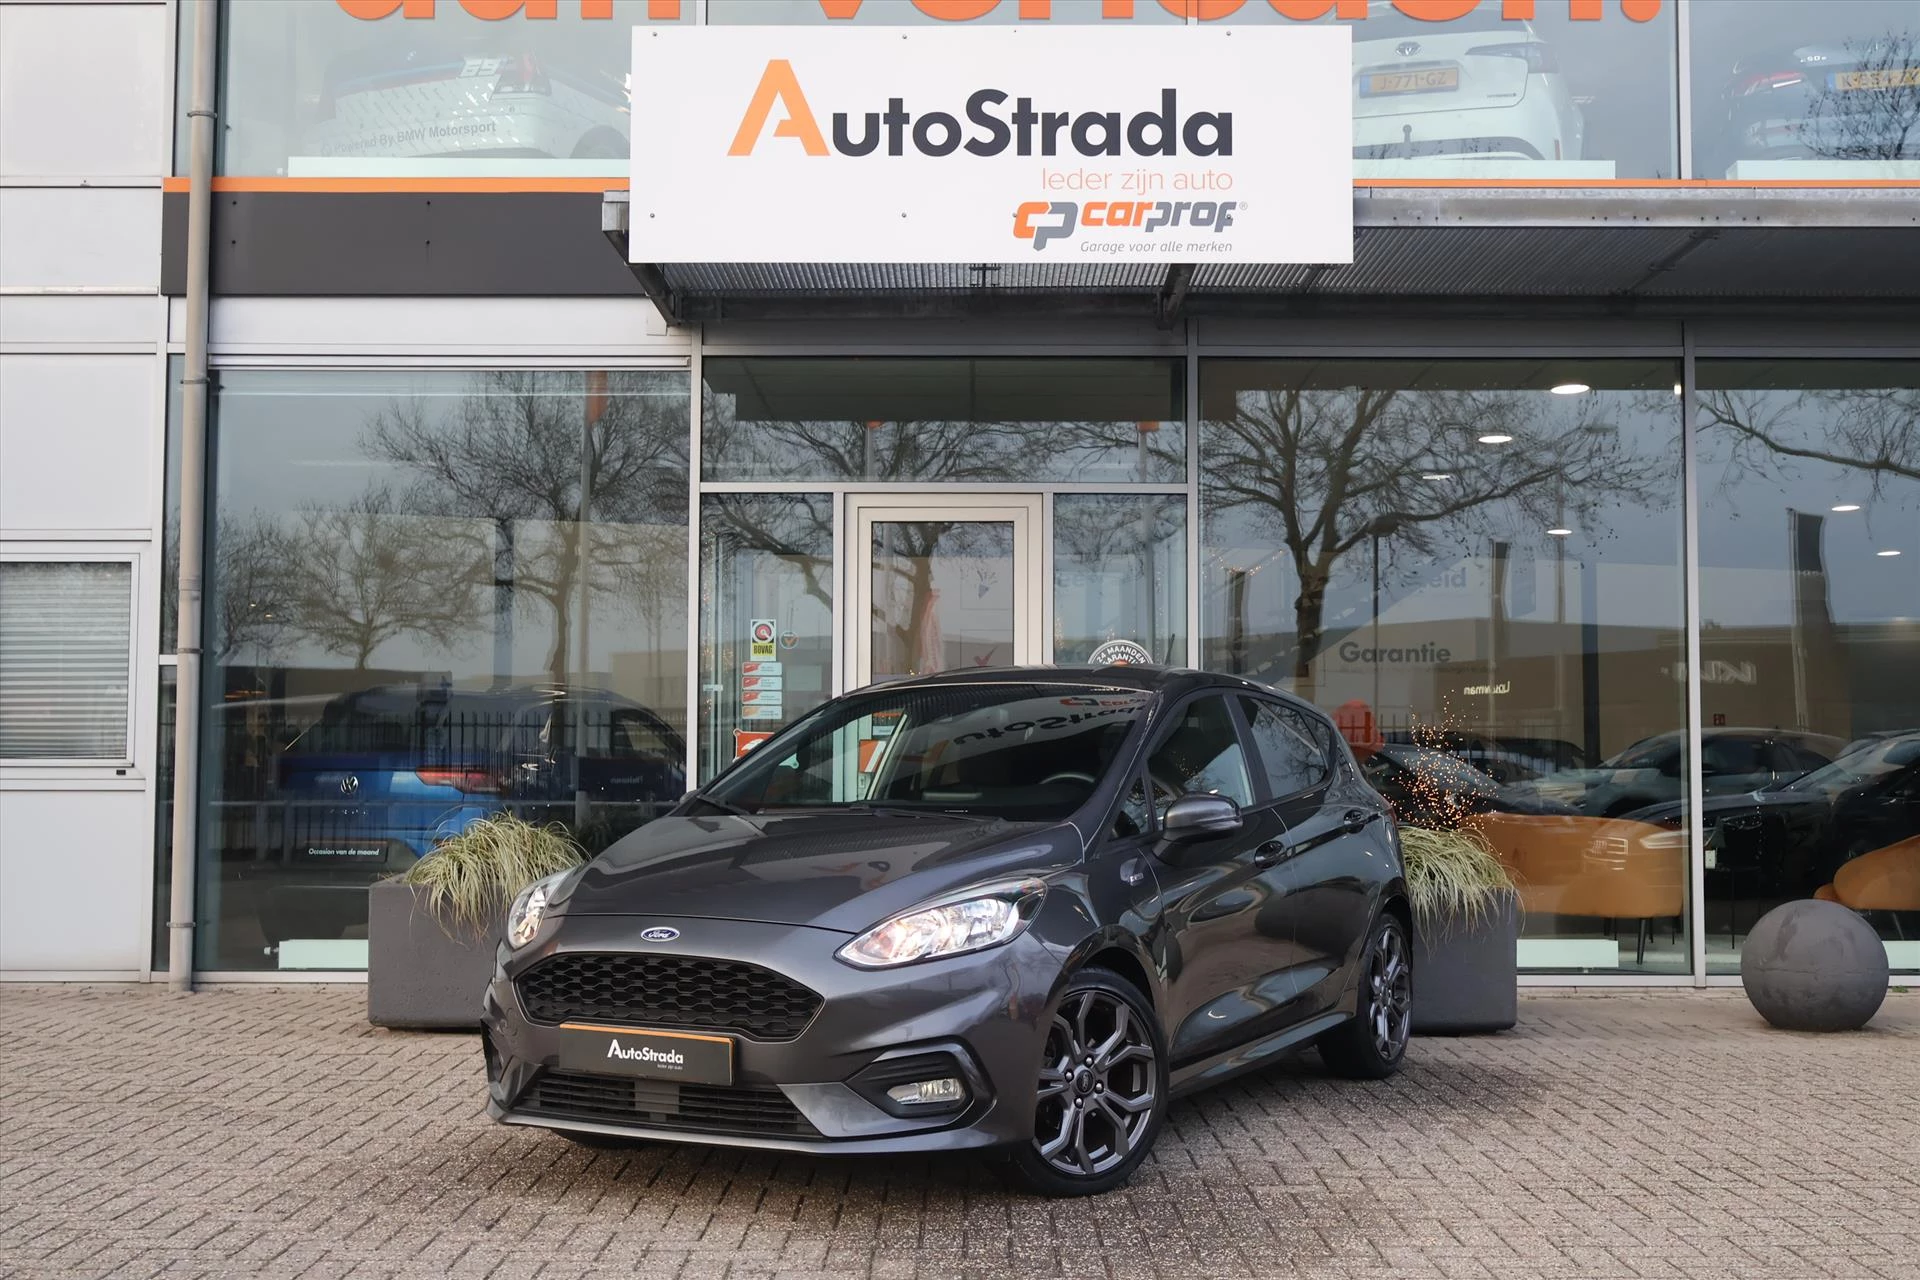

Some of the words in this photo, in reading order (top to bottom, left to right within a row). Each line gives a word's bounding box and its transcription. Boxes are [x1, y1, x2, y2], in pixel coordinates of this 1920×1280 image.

[727, 59, 1233, 157] AutoStrada
[334, 135, 377, 152] Powered
[379, 133, 395, 147] By
[397, 128, 426, 143] BMW
[429, 121, 497, 139] Motorsport
[1121, 169, 1164, 196] zijn
[1173, 170, 1233, 191] auto
[1081, 202, 1237, 233] carprof
[1080, 241, 1125, 255] Garage
[1129, 243, 1157, 252] voor
[1160, 240, 1184, 252] alle
[1187, 240, 1233, 252] merken
[753, 644, 773, 655] BOVAG
[1096, 652, 1106, 663] 24
[1107, 645, 1147, 664] MAANDEN
[1339, 641, 1451, 663] Garantie
[308, 847, 335, 856] Occasion
[348, 847, 356, 856] de
[357, 848, 380, 856] maand
[607, 1039, 684, 1065] AutoStrada
